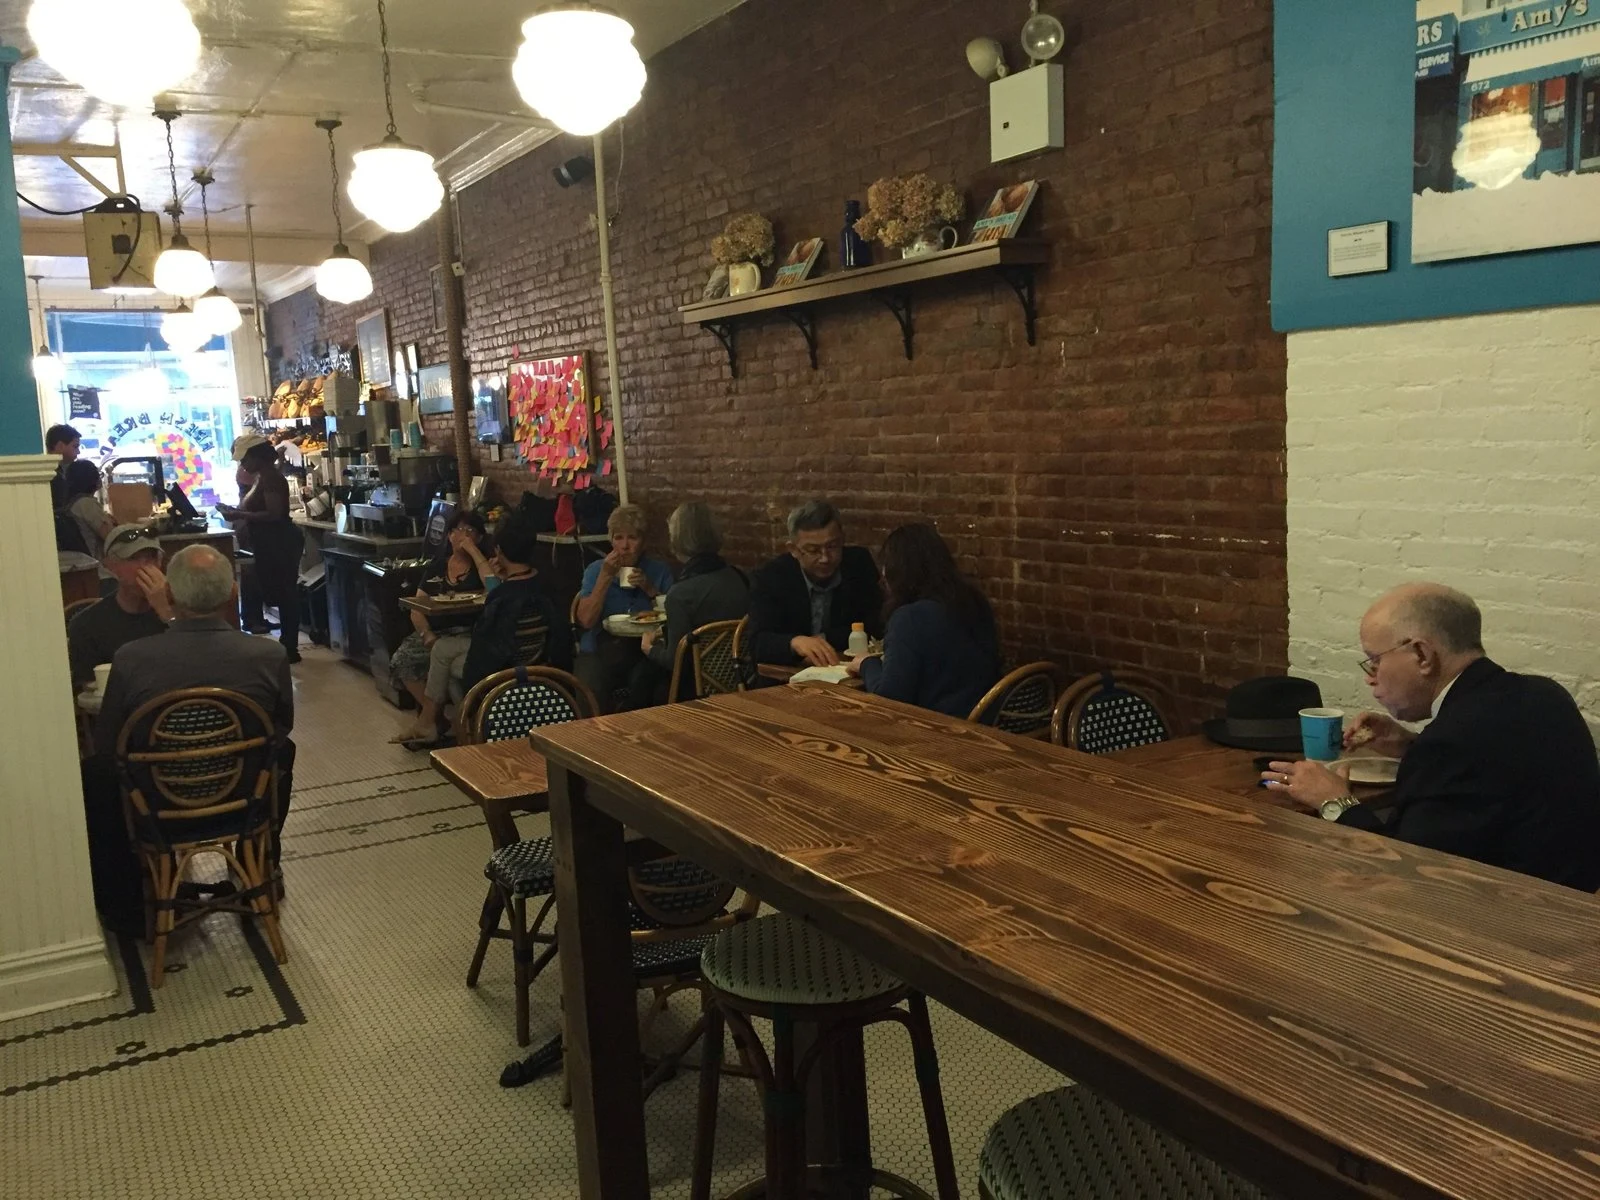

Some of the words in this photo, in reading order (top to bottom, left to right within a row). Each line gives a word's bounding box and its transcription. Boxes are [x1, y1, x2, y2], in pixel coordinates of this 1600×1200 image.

[1511, 0, 1588, 32] Amy's
[1416, 21, 1443, 47] RS
[1471, 81, 1490, 92] 672
